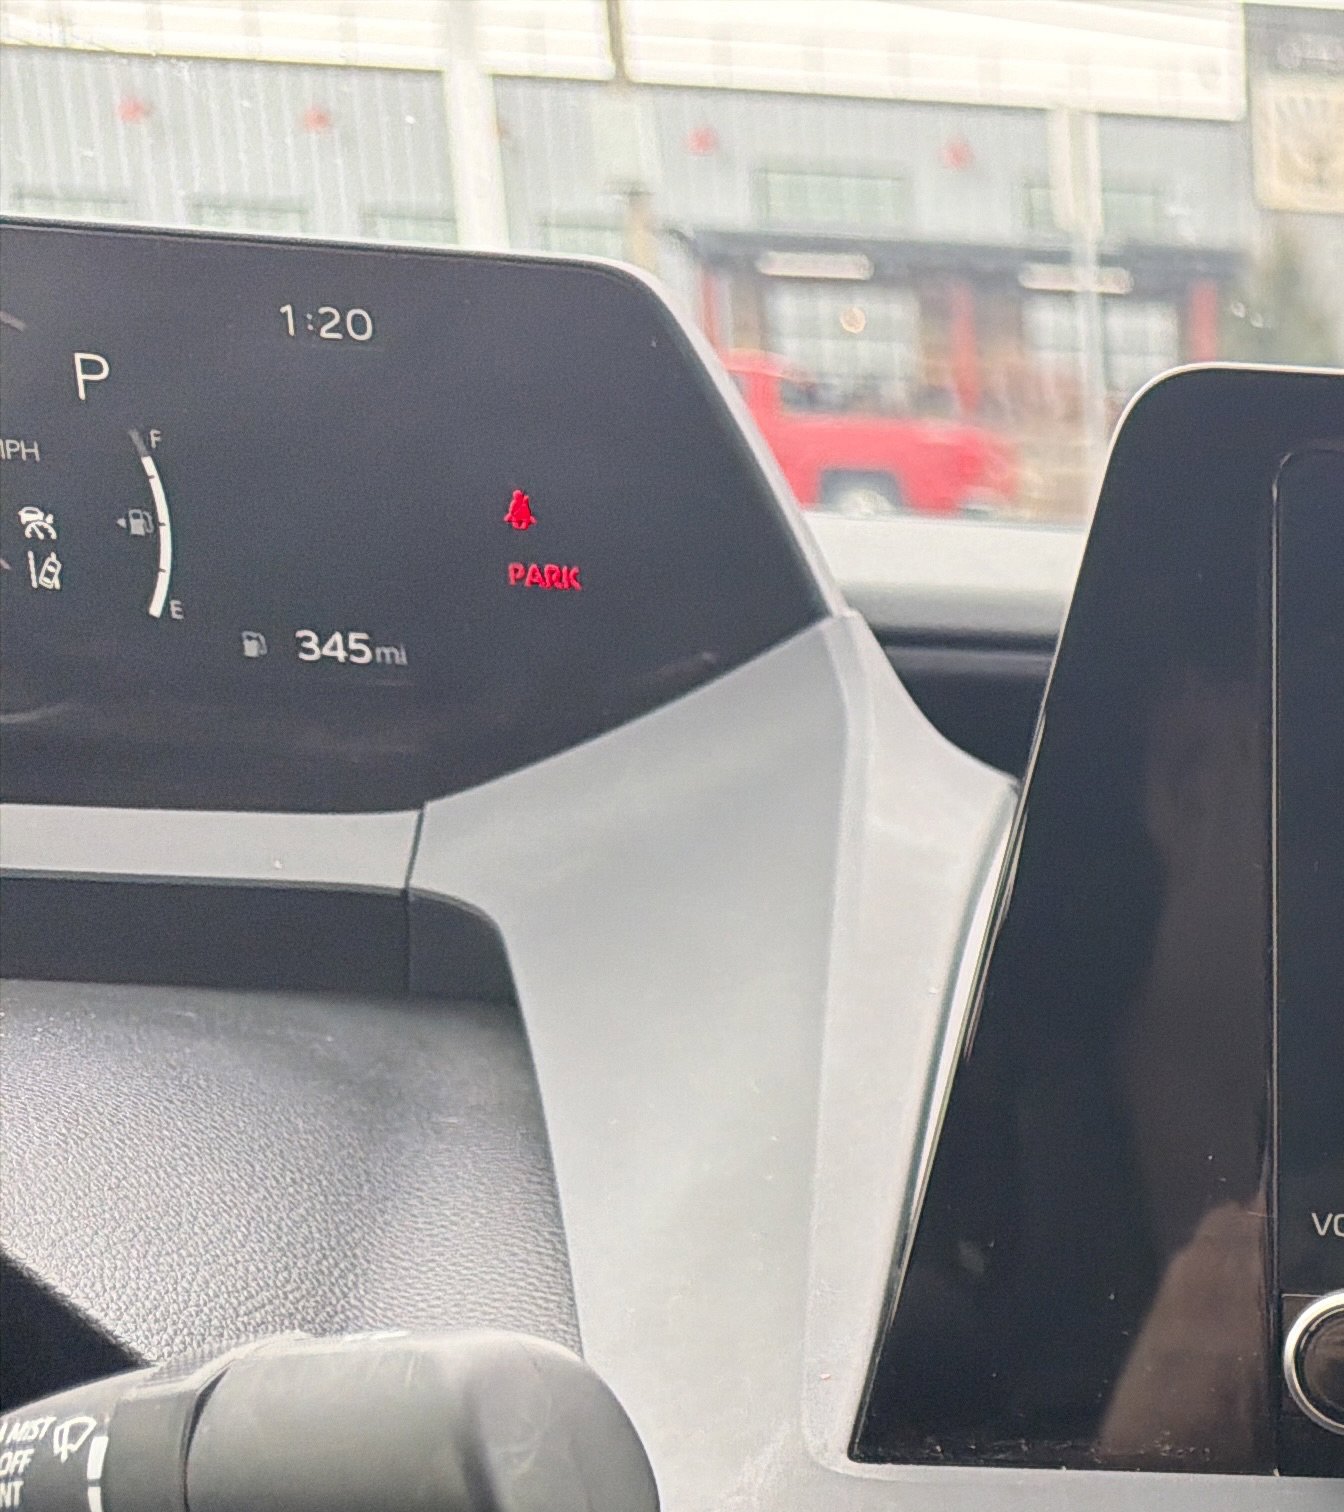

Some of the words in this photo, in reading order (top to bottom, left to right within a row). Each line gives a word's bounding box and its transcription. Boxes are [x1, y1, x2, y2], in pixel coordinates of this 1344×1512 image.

[280, 304, 374, 342] 1:20
[73, 353, 110, 400] P
[149, 430, 162, 449] F
[508, 562, 583, 591] PARK
[170, 600, 185, 620] E
[5, 1415, 57, 1444] MIST
[0, 1480, 25, 1509] NT
